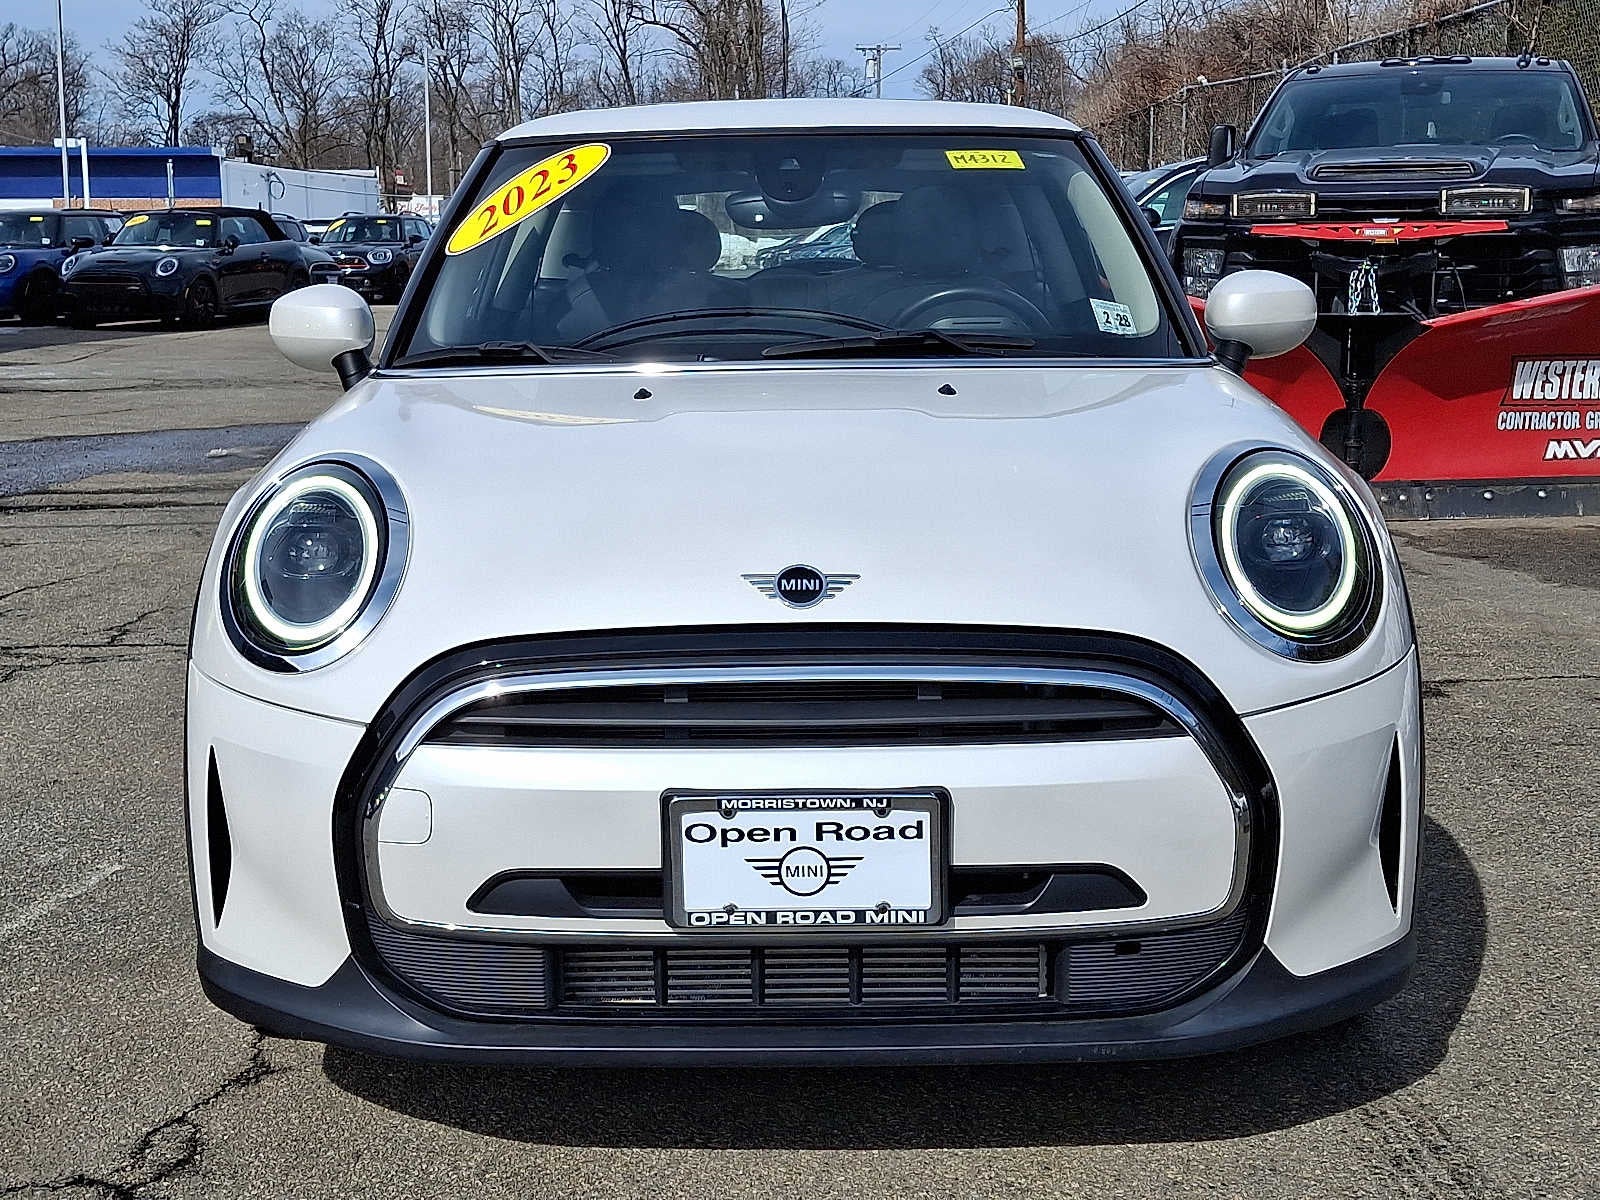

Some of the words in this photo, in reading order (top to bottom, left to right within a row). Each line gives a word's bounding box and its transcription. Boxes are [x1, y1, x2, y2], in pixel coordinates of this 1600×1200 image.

[477, 153, 578, 238] 2023
[1102, 310, 1112, 325] 2
[1512, 360, 1600, 400] WESTER
[1497, 411, 1581, 431] CONTRACTOR
[781, 579, 820, 591] MINI
[720, 799, 856, 810] MORRISTOWN,
[863, 798, 888, 809] NJ
[684, 822, 797, 848] Open
[815, 820, 924, 842] Road
[785, 865, 824, 878] MINI
[689, 911, 767, 926] OPEN
[776, 911, 856, 925] ROAD
[865, 910, 925, 924] MINI
